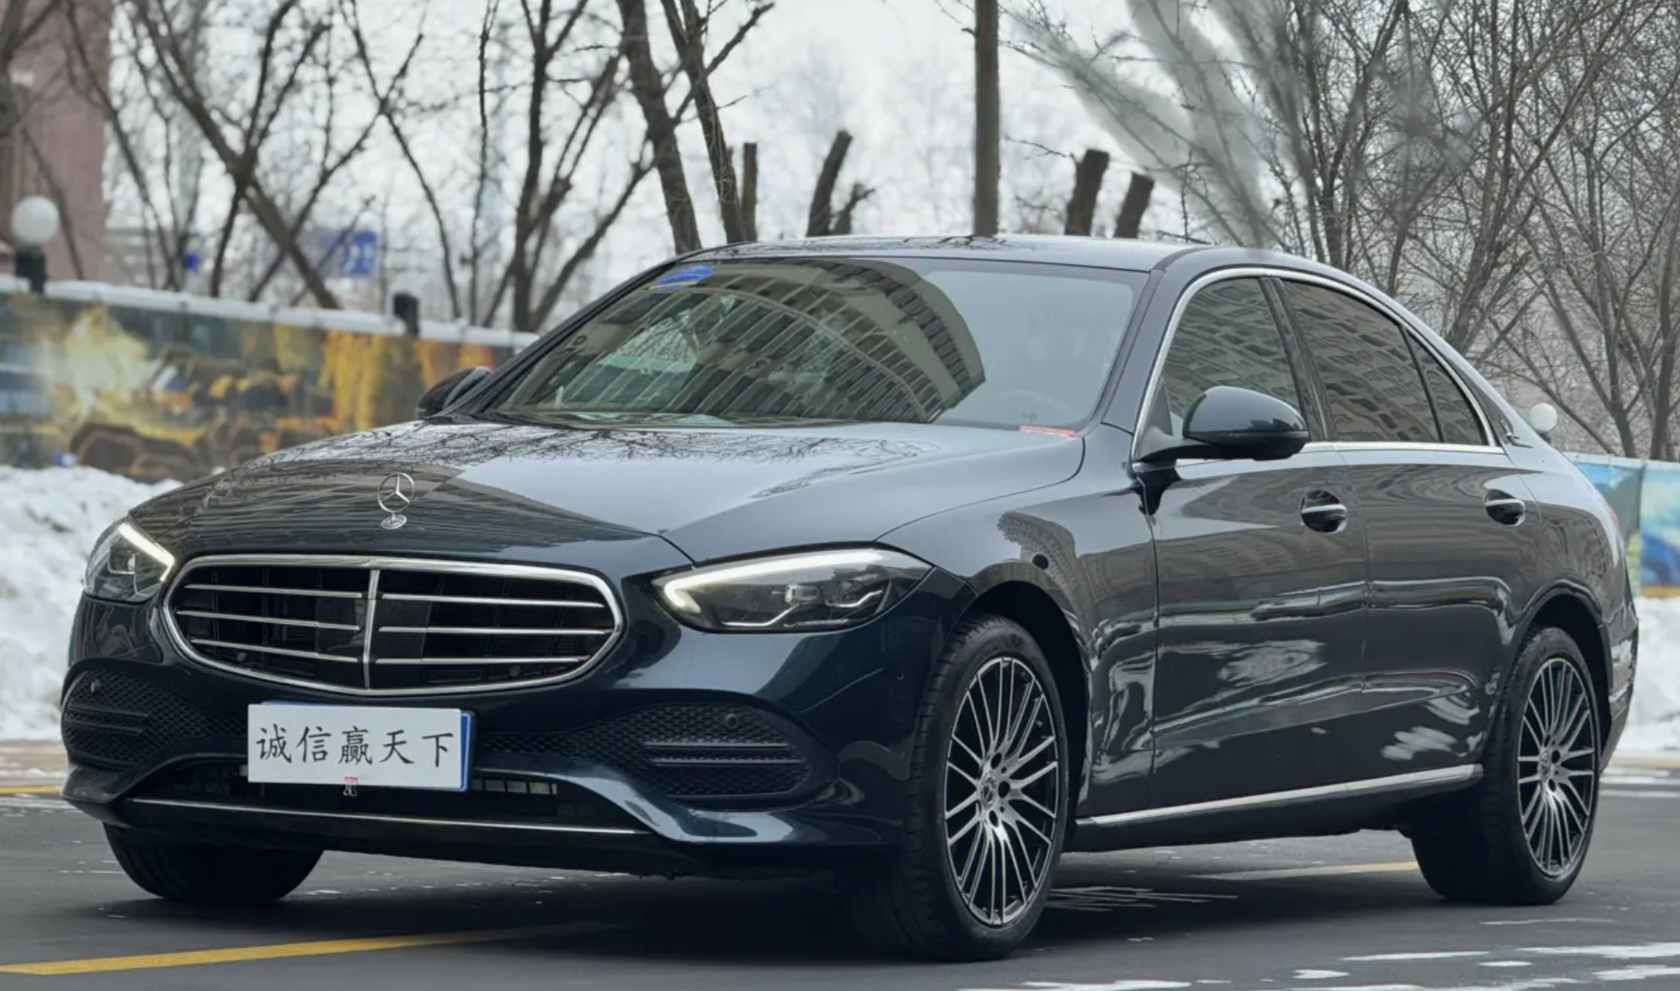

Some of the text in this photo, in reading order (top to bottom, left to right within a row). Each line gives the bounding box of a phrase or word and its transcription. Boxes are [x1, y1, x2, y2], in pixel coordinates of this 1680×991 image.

[255, 723, 454, 768] 诚信赢天下
